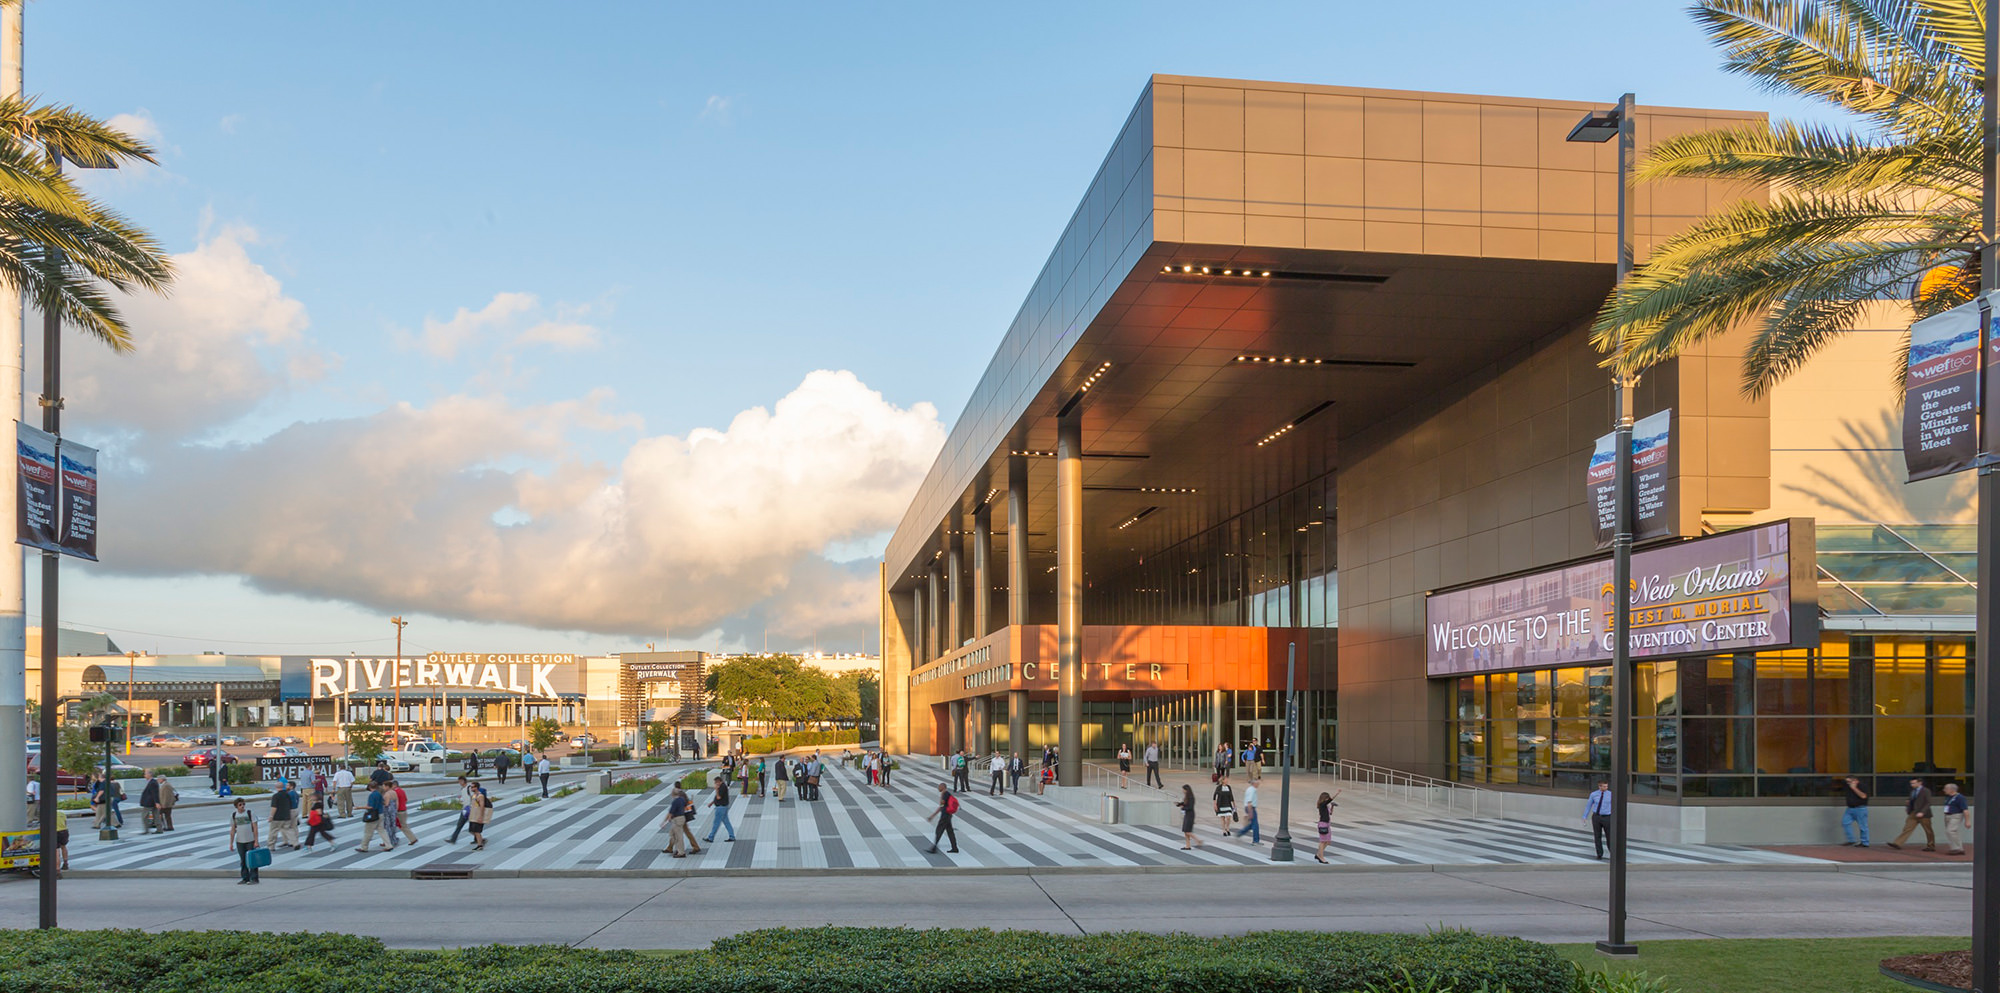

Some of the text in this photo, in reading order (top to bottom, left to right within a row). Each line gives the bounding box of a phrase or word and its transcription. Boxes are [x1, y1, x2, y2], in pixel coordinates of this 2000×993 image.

[1925, 355, 1972, 376] weftec
[1922, 385, 1961, 401] Where
[1920, 401, 1972, 421] Greatest
[1921, 402, 1939, 412] the
[1920, 416, 1959, 431] Minds
[1920, 423, 1970, 442] in Water
[1920, 436, 1951, 451] Meet
[1641, 450, 1665, 463] weftec
[1597, 465, 1615, 477] wef
[1640, 472, 1660, 482] Where
[1597, 485, 1615, 495] Wher
[1639, 485, 1665, 497] Greatest
[1597, 494, 1608, 502] the
[1597, 499, 1615, 509] Great
[1639, 494, 1659, 505] Minds
[1599, 506, 1615, 516] Mind
[1645, 501, 1664, 511] Water
[1639, 510, 1655, 520] Meet
[1630, 563, 1769, 605] New Orleans
[1608, 596, 1764, 627] ENEST N. MORIAL
[1524, 615, 1548, 641] TO
[1556, 608, 1591, 637] THE
[1603, 628, 1698, 652] CVENTION
[428, 654, 573, 664] OUTLET COLLECTION
[310, 658, 559, 699] RIVERWALK
[637, 671, 677, 680] RIVERWALK
[290, 756, 330, 764] COLLECTION
